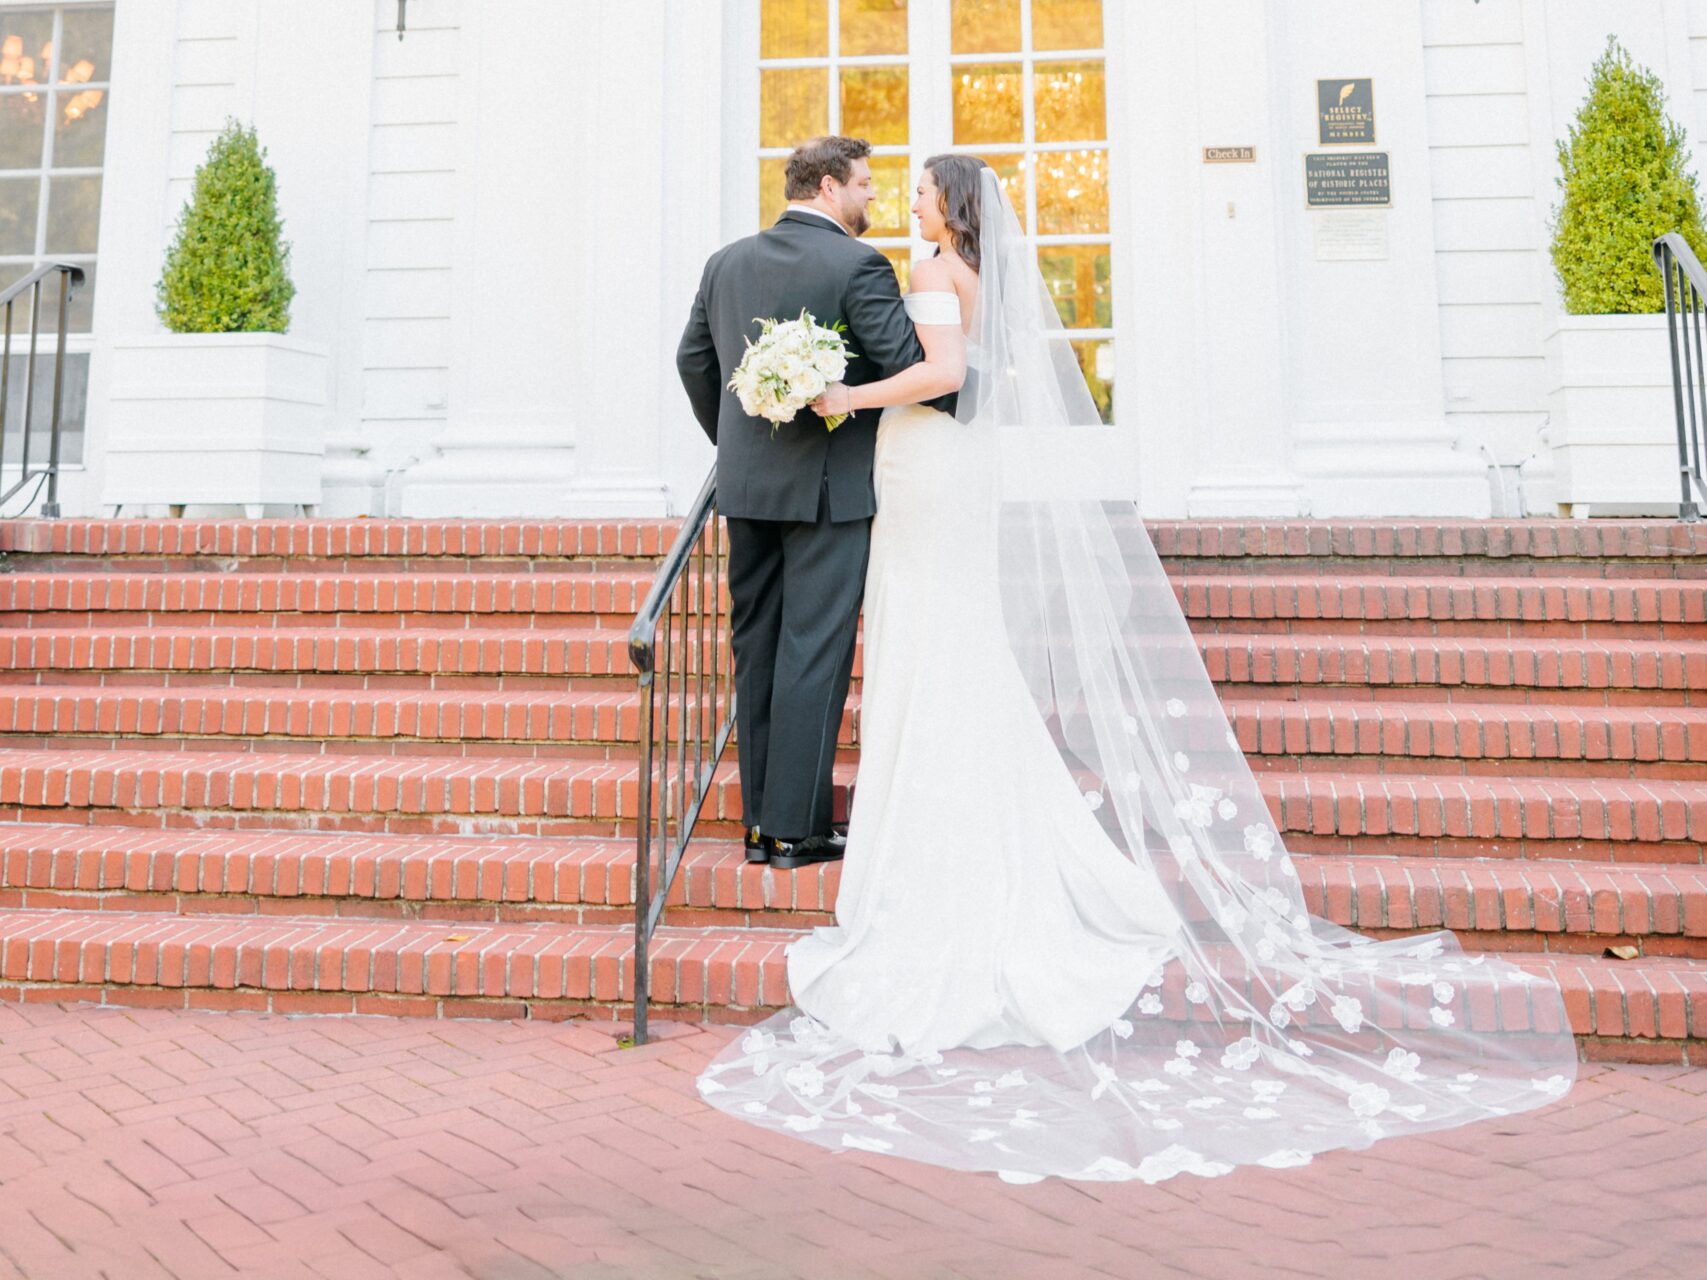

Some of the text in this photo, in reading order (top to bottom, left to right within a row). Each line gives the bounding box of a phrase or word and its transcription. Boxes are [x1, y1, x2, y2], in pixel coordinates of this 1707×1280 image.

[1208, 148, 1250, 159] Check In
[1308, 169, 1387, 177] NATIONAL REGISTER
[1322, 180, 1356, 188] HISTORIC
[1359, 179, 1388, 187] PLACES
